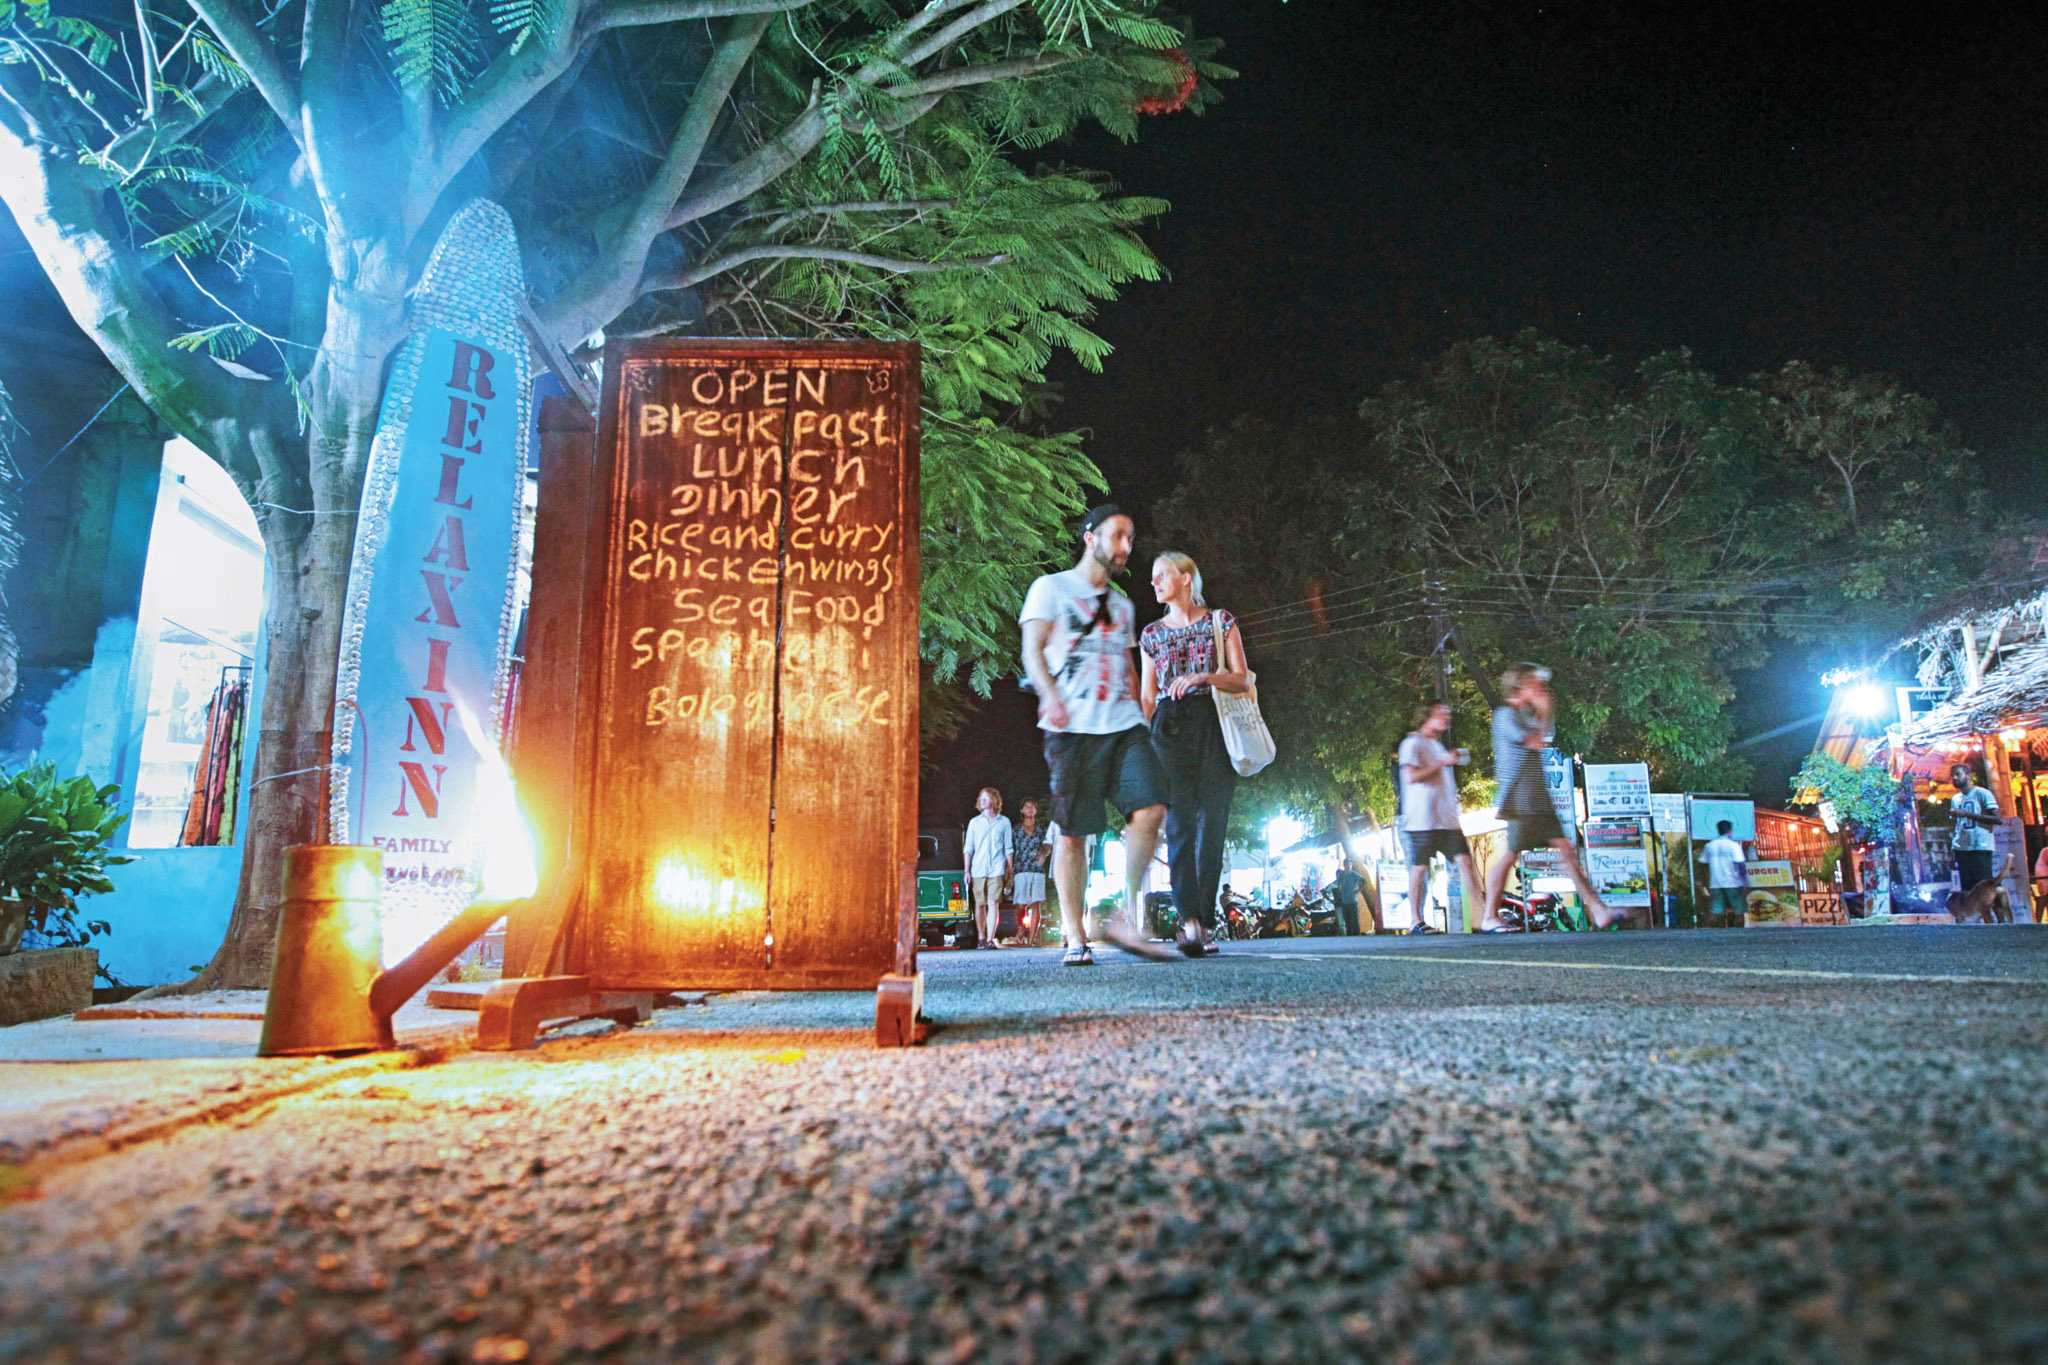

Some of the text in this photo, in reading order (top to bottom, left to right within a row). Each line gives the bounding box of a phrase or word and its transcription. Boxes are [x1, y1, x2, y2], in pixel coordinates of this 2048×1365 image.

[691, 369, 827, 406] OPEN
[414, 339, 497, 629] RELAX
[692, 442, 866, 488] Lunch
[391, 637, 455, 819] INN
[372, 836, 452, 853] FAMILY
[1747, 867, 1779, 876] URGER
